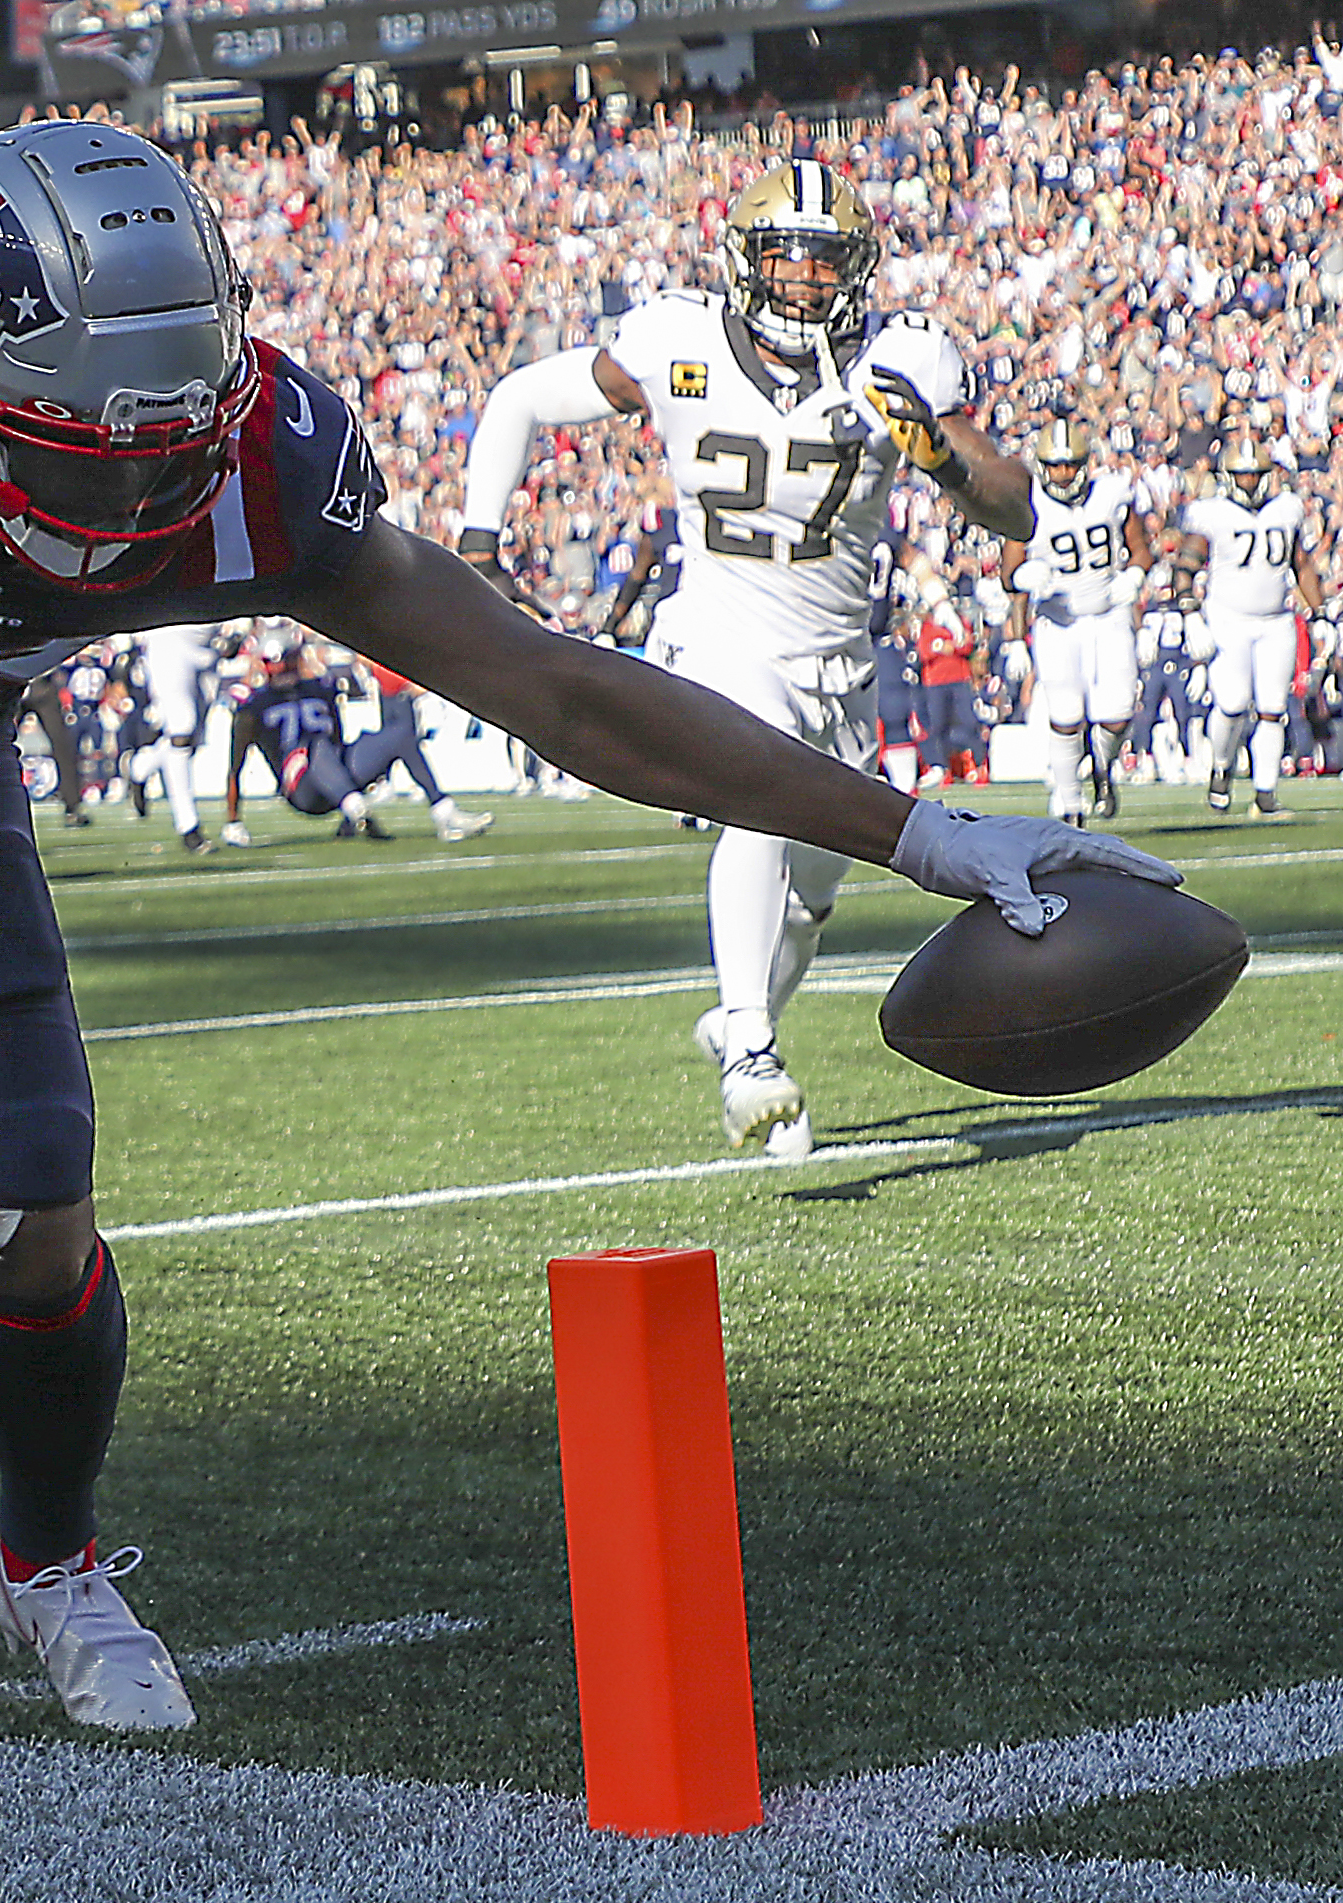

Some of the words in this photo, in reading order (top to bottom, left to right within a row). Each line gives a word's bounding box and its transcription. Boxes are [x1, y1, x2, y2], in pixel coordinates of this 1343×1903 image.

[378, 13, 426, 43] 182
[697, 430, 862, 561] 27
[1051, 524, 1111, 573] 99
[1234, 527, 1286, 567] 70
